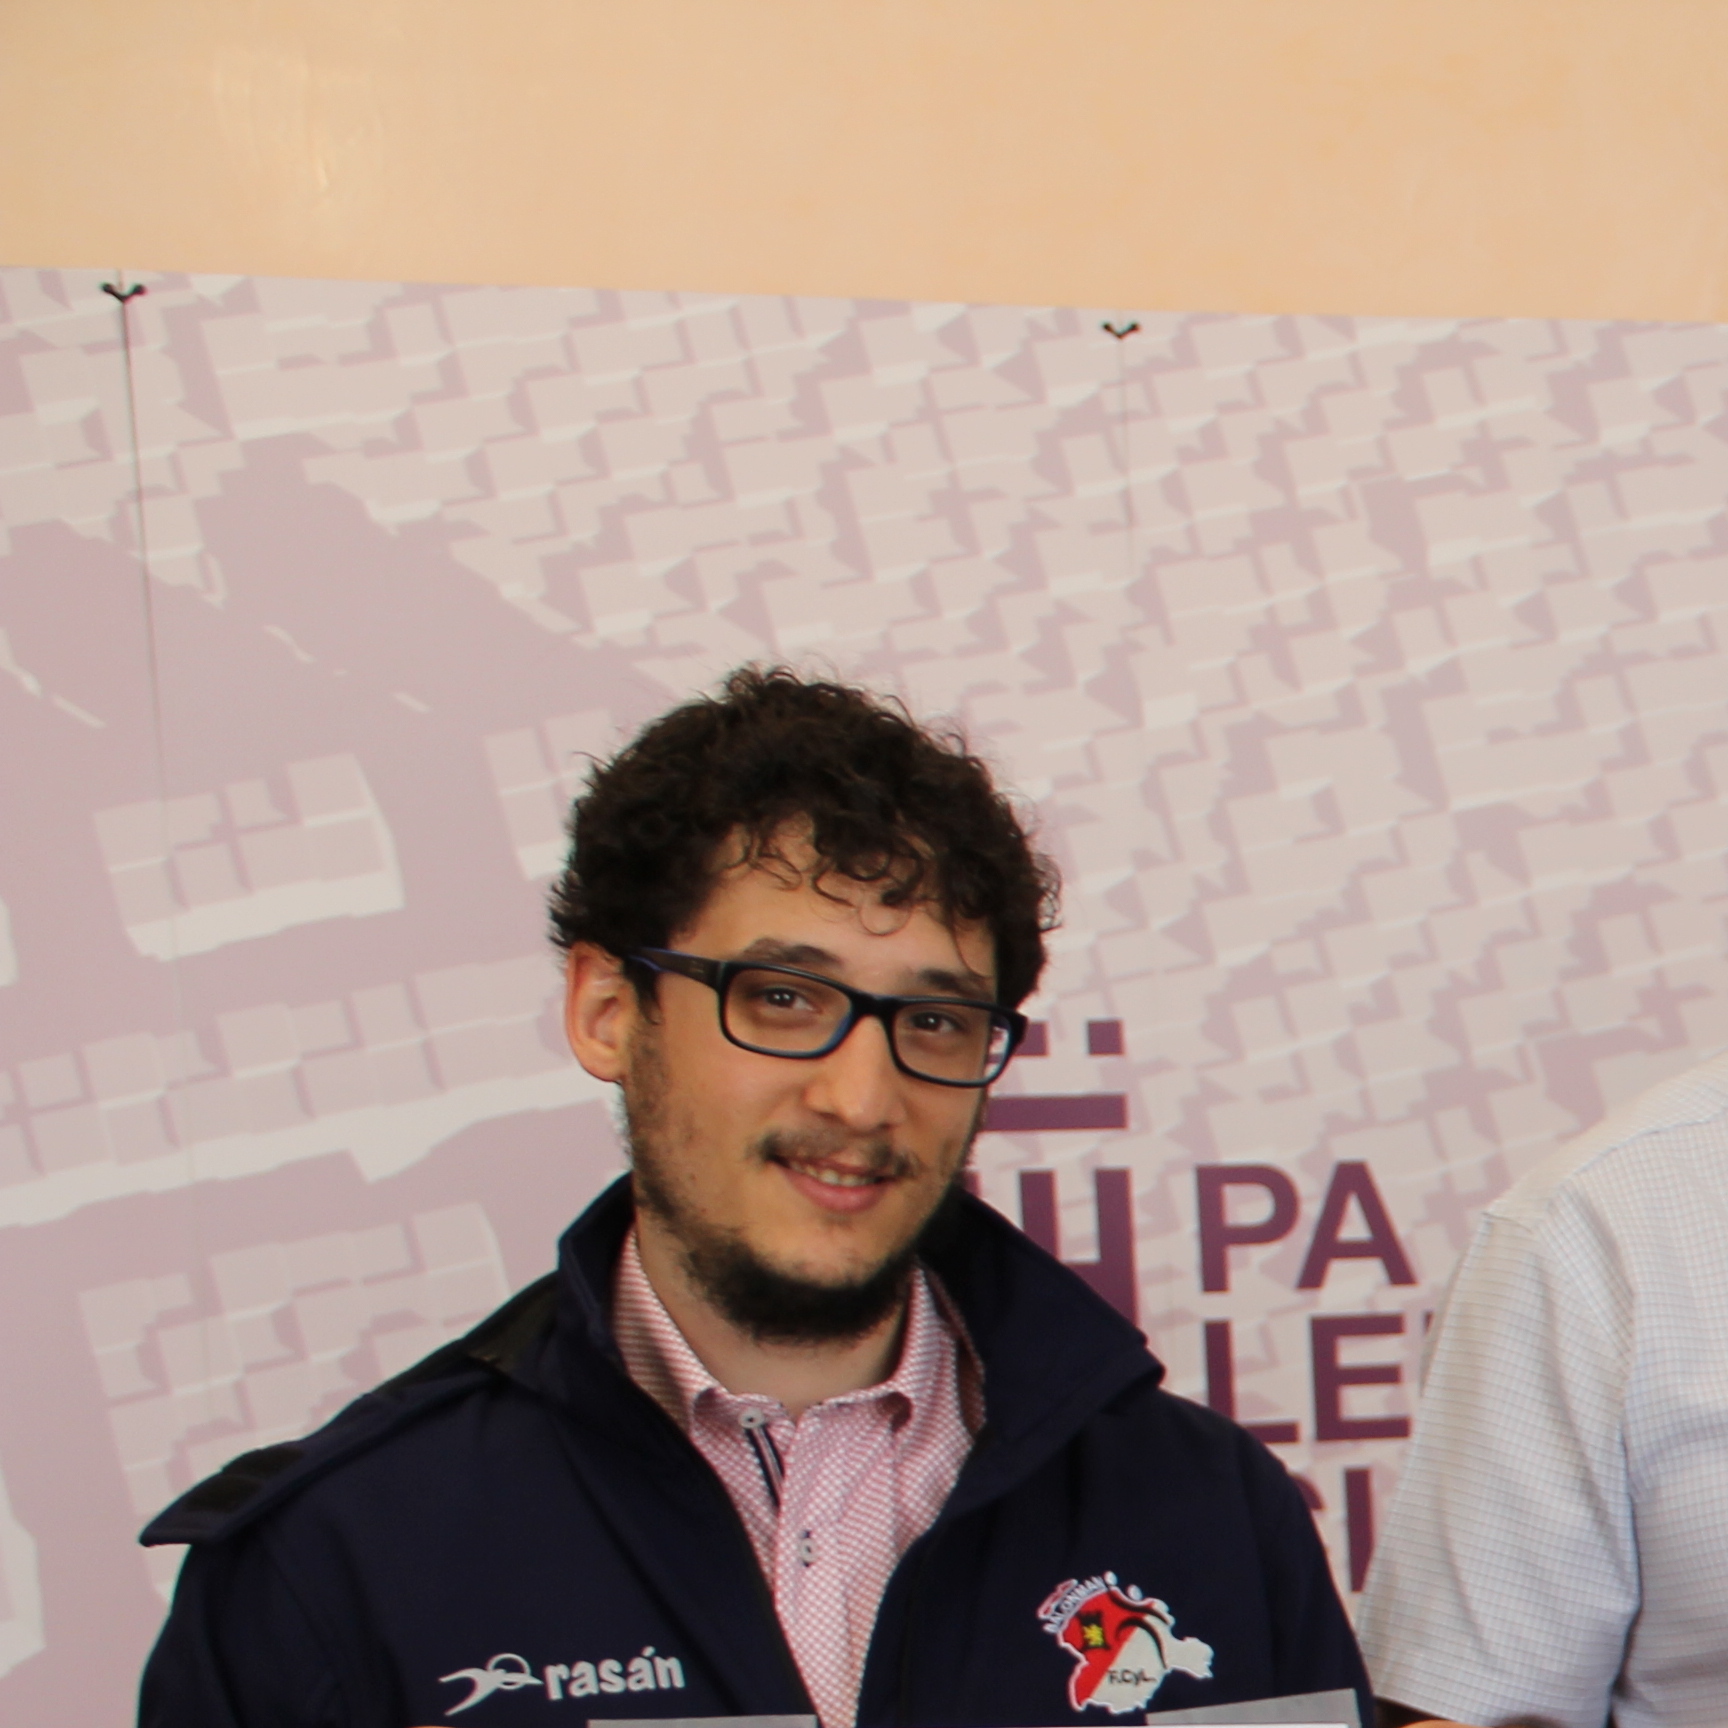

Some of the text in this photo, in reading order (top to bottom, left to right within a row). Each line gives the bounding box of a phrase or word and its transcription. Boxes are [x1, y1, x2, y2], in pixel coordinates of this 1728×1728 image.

[1196, 1160, 1418, 1293] PA
[1203, 1310, 1435, 1443] LE
[545, 1646, 685, 1701] rasán
